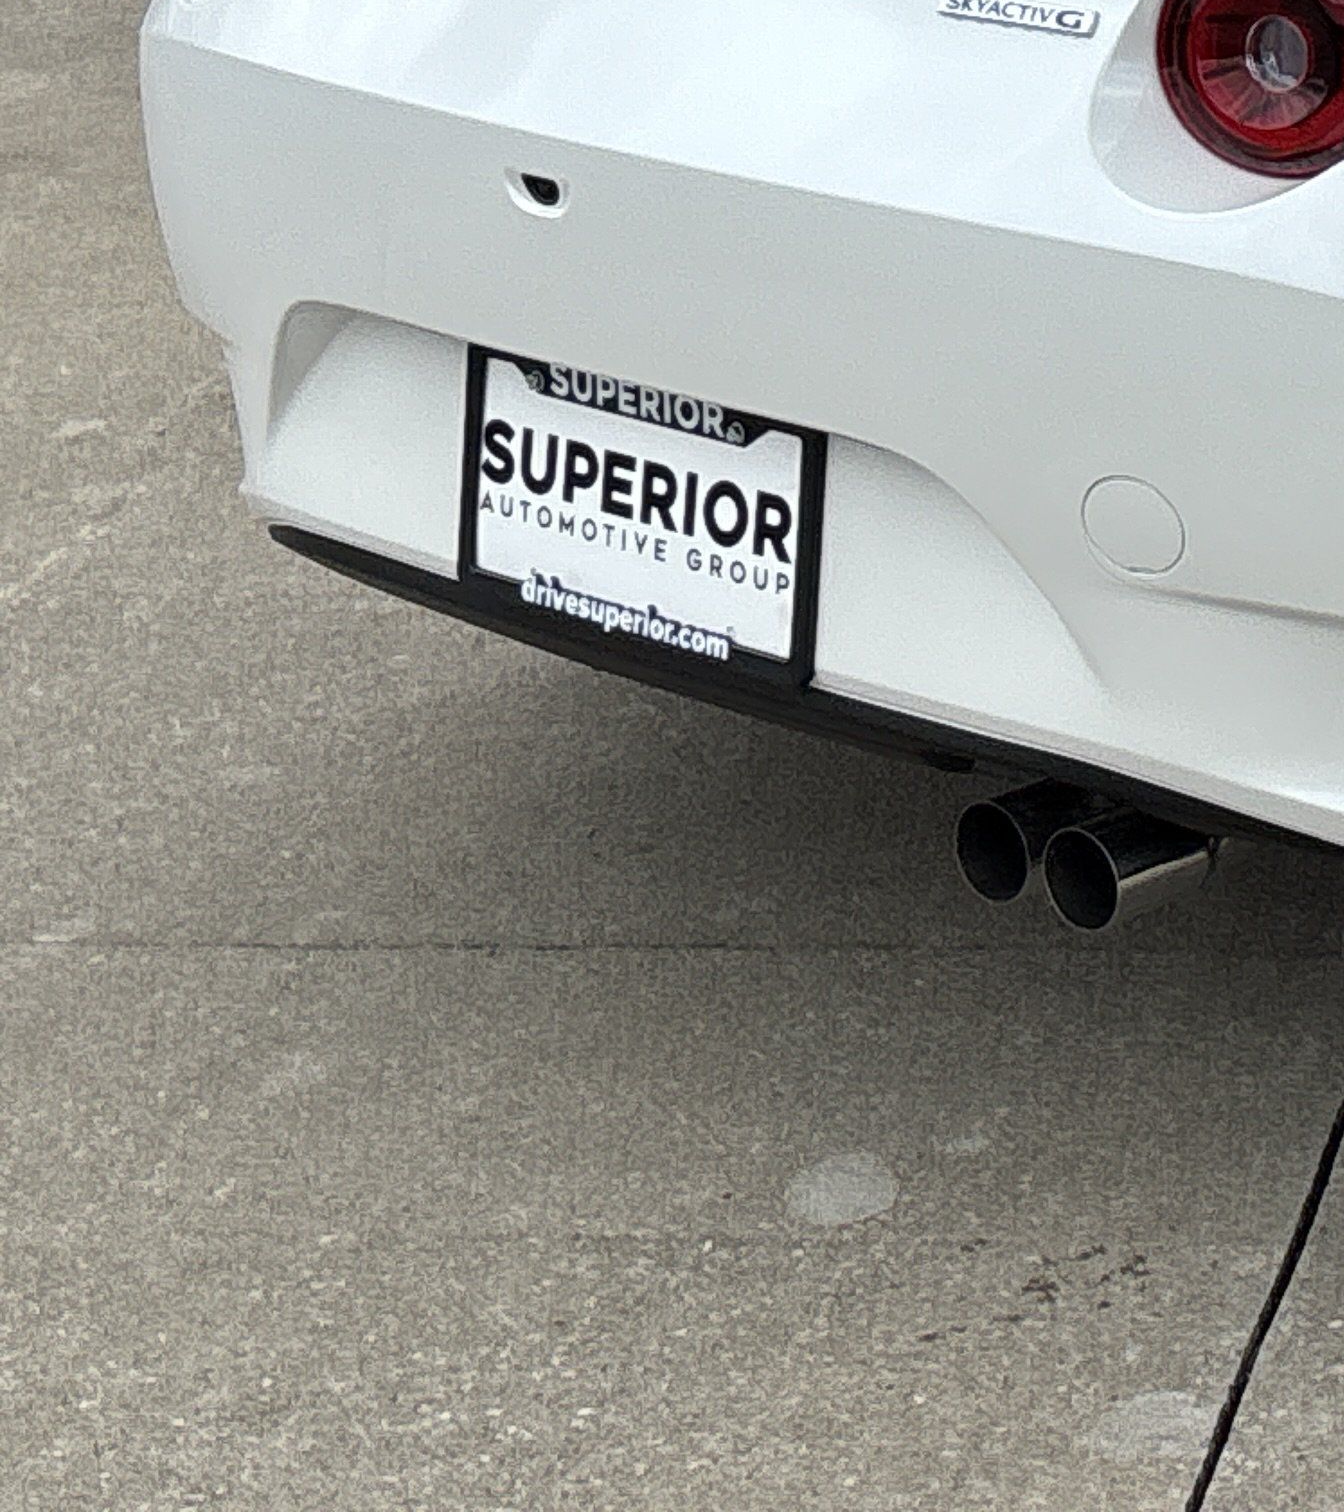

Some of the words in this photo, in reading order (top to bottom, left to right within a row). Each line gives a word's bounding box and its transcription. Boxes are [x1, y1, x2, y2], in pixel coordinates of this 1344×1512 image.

[549, 361, 726, 439] SUPERIOR
[481, 418, 794, 564] SUPERIOR
[480, 489, 668, 563] AUTOMOTIVE
[686, 547, 791, 595] GROUP
[520, 575, 730, 662] drivesuperior.com
